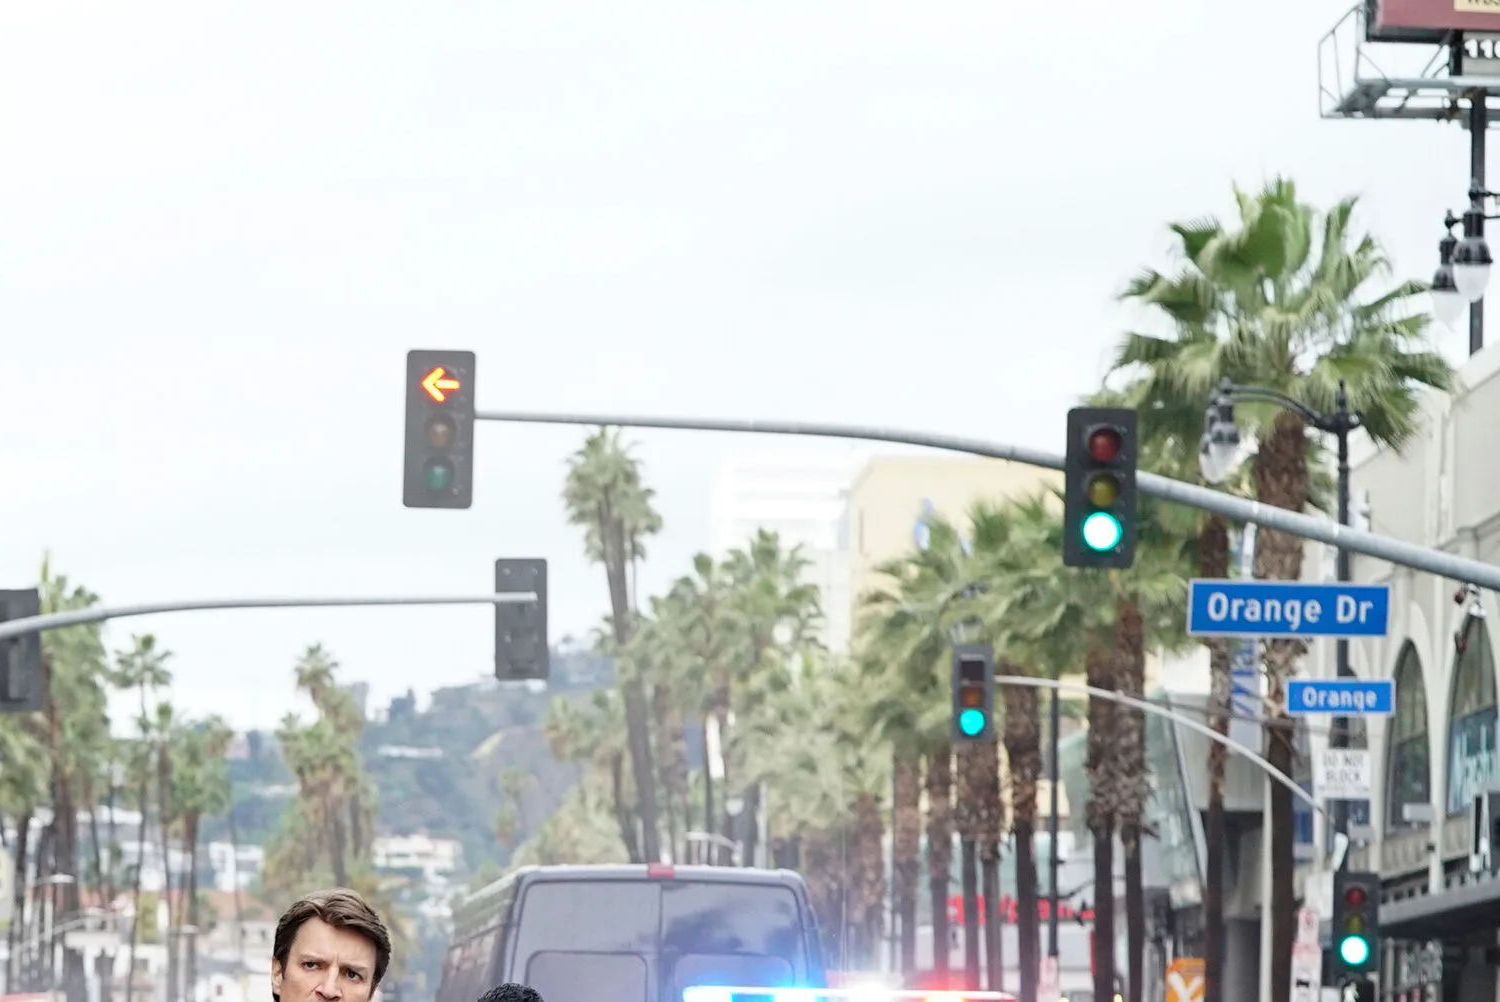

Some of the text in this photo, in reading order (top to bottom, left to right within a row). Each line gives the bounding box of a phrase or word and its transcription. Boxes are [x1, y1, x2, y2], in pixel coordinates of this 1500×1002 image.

[1207, 591, 1373, 631] Orange Dr
[1302, 686, 1377, 713] Orange
